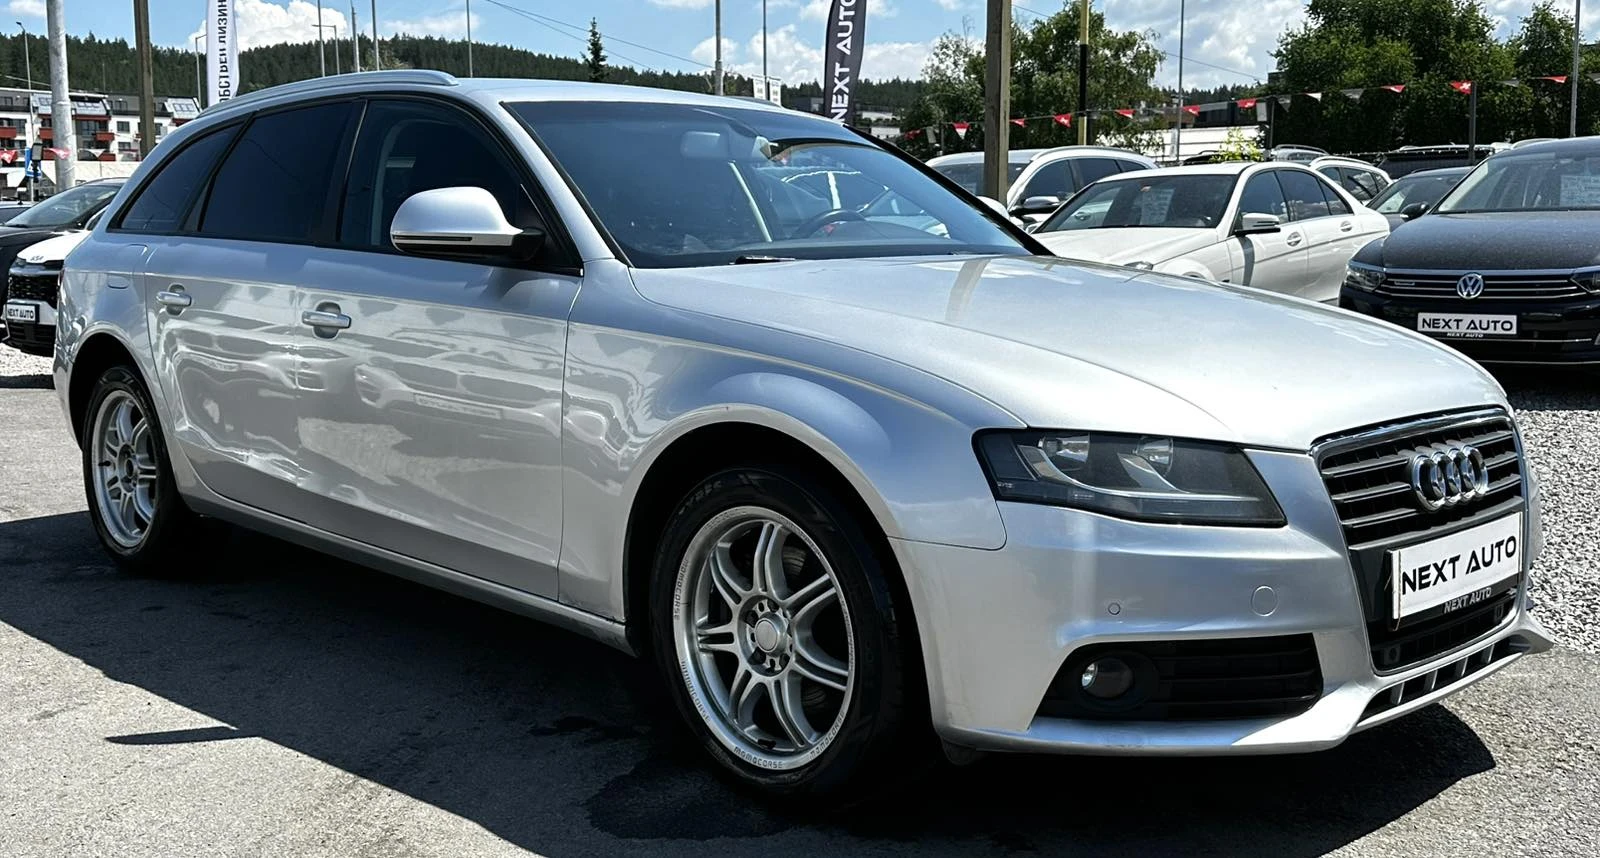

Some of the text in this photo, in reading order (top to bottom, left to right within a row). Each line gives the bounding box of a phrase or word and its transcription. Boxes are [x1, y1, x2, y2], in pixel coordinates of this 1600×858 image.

[830, 62, 850, 123] NEXT
[20, 309, 34, 319] AUTO
[1421, 317, 1513, 331] NEXT AUTO
[1401, 535, 1517, 595] NEXT AUTO
[1444, 587, 1492, 613] NEXT AUTO
